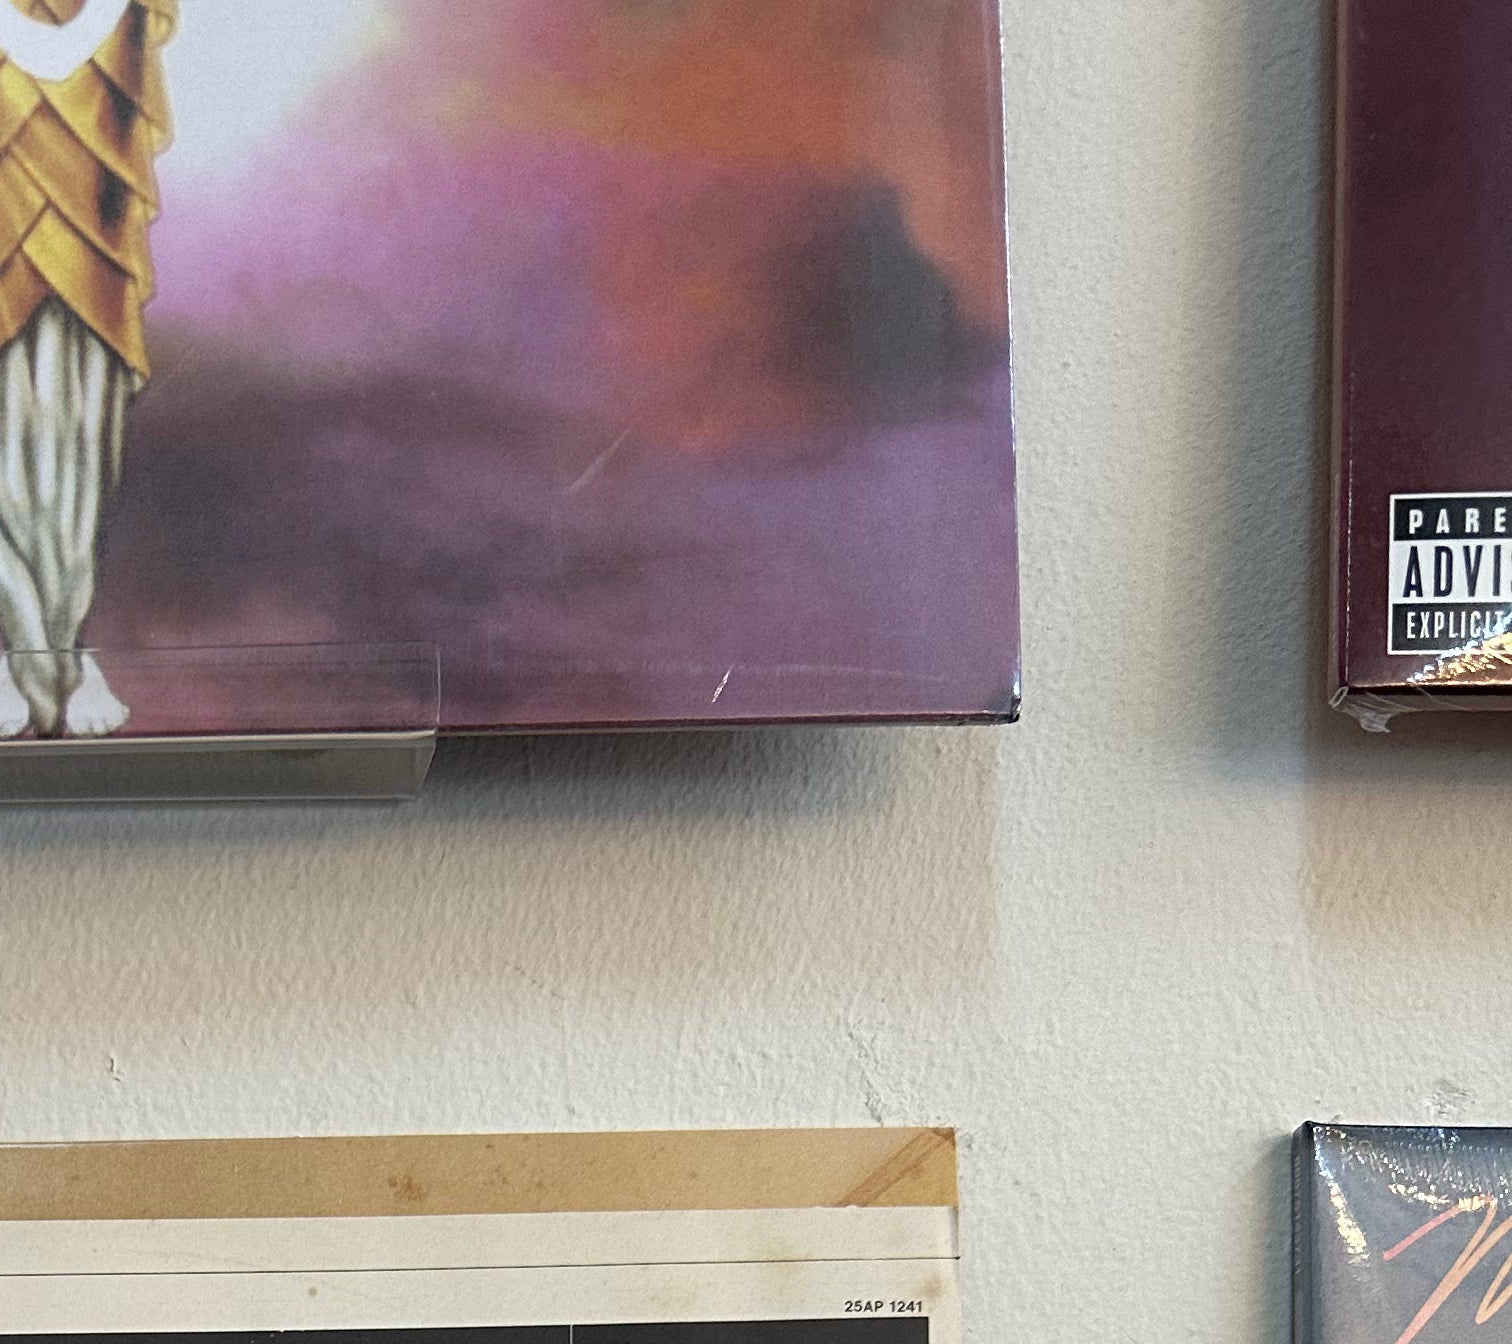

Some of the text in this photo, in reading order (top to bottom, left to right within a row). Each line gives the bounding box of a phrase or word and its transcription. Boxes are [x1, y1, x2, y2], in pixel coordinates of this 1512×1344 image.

[1403, 545, 1512, 598] ADVI
[845, 1300, 922, 1312] 25AP 1241
